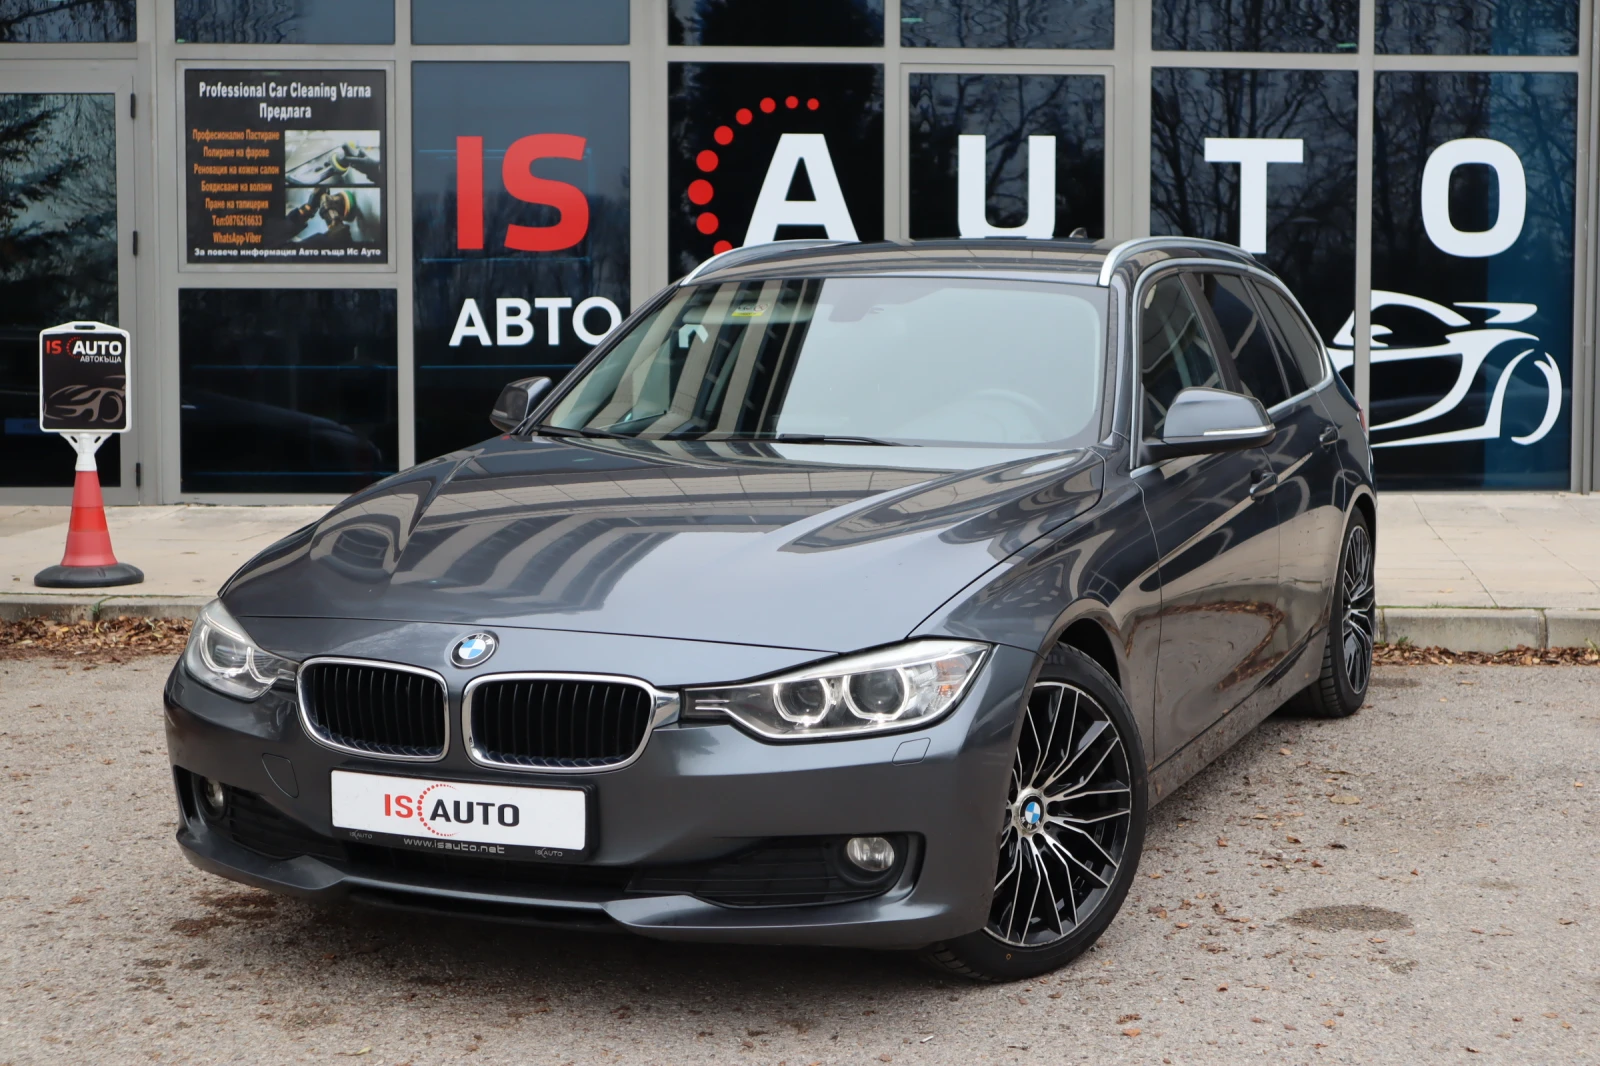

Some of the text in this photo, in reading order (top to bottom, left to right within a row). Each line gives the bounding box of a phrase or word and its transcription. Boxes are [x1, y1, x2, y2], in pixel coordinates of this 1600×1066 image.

[199, 82, 371, 101] Professional Car Cleaning Varna
[259, 103, 312, 121] Предлага
[192, 128, 280, 143] Професионално Пастиране
[203, 145, 270, 160] Полиране на фарове
[194, 163, 279, 176] Реновация на кожен салон
[201, 180, 273, 193] Боядисване на волани
[456, 133, 590, 252] IS
[205, 197, 269, 211] Пране на тапицерия
[212, 232, 262, 246] WhatsApp-Viber
[194, 248, 205, 256] За
[240, 248, 296, 258] информация
[299, 248, 319, 256] Авто
[321, 249, 345, 257] къща
[347, 248, 358, 256] Ис
[361, 248, 381, 257] Ауто
[448, 296, 622, 346] АВТО
[45, 340, 122, 355] IS AUTO
[384, 793, 519, 827] IS AUTO
[403, 837, 505, 854] www.isauto.net
